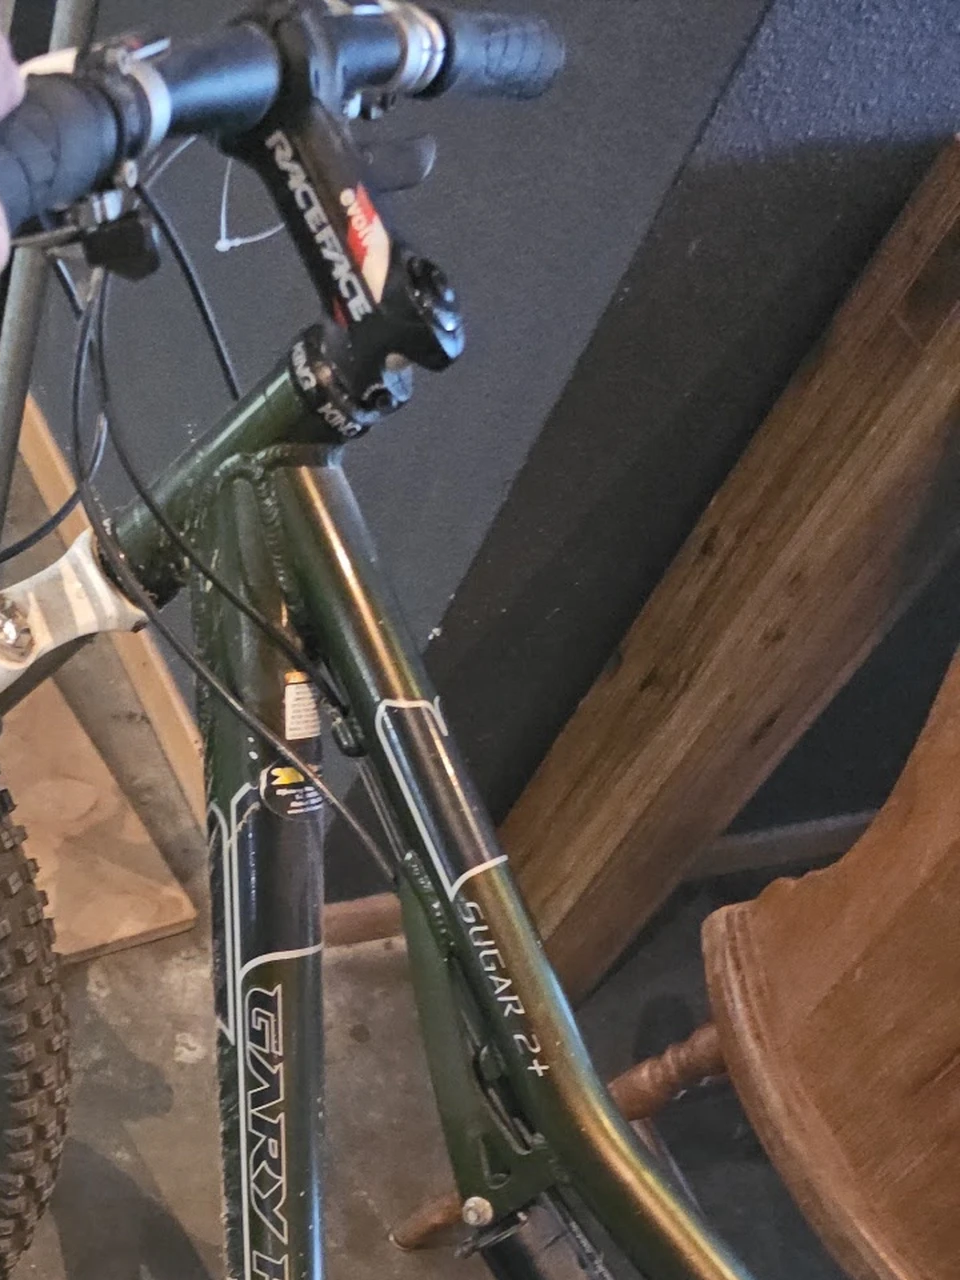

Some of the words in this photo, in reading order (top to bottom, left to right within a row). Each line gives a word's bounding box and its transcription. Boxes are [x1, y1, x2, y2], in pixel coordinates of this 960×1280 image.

[291, 340, 317, 391] KING
[317, 402, 362, 438] KING
[462, 901, 526, 1018] SUGAR
[513, 1034, 550, 1077] 2+
[245, 983, 288, 1244] GARY
